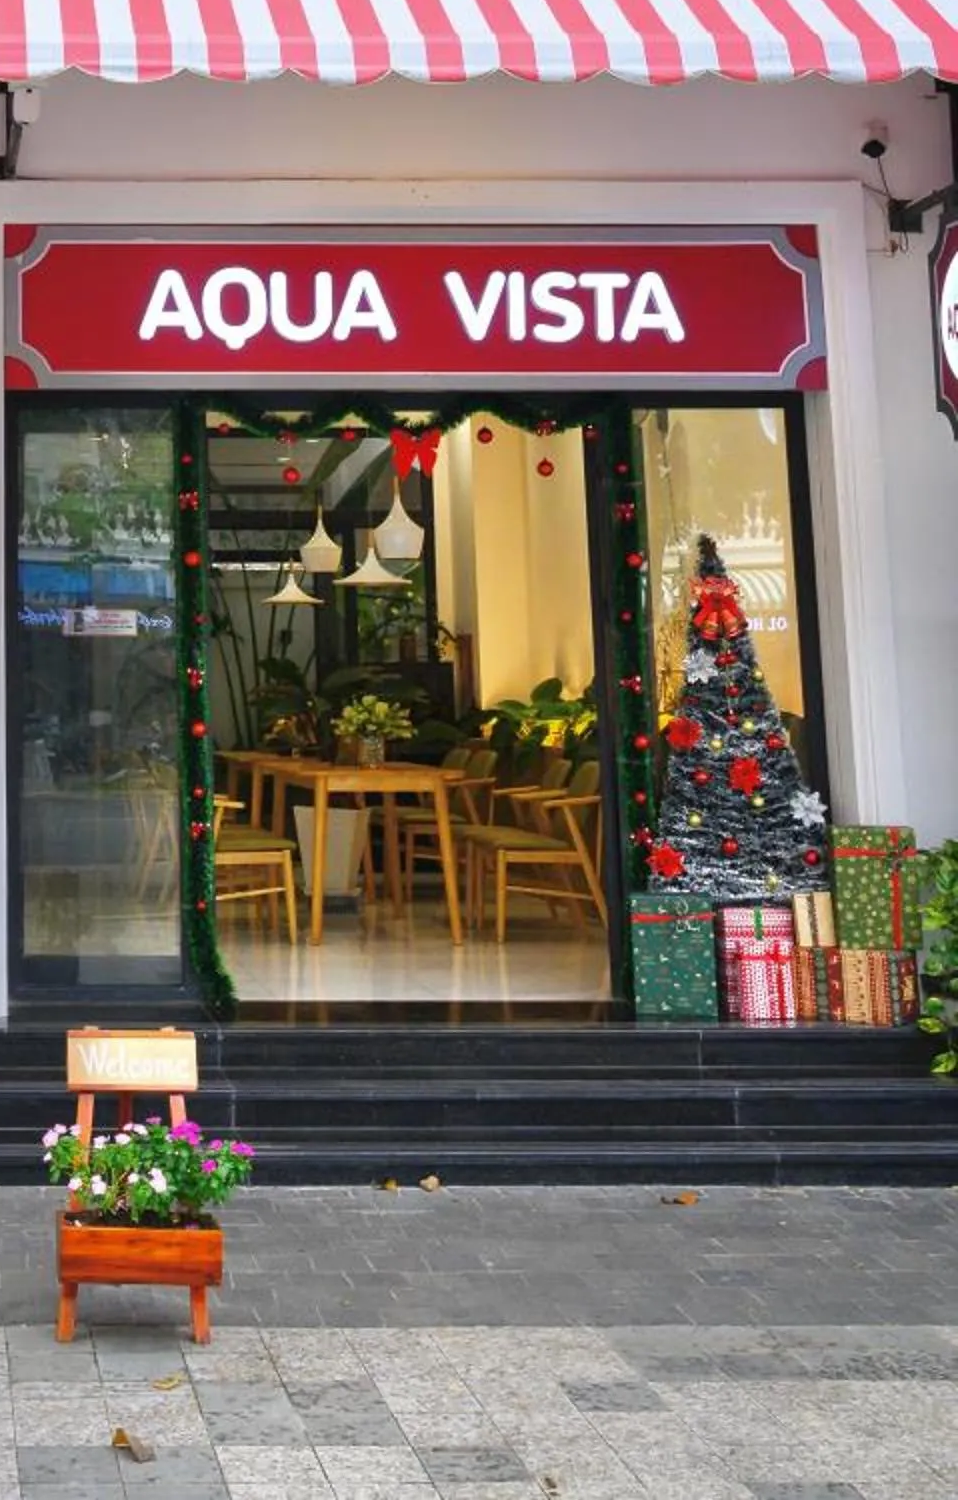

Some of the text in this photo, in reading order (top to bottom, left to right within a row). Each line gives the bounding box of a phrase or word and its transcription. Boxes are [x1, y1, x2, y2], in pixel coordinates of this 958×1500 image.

[139, 266, 685, 350] AQUA VISTA
[76, 1039, 190, 1080] Welcome
